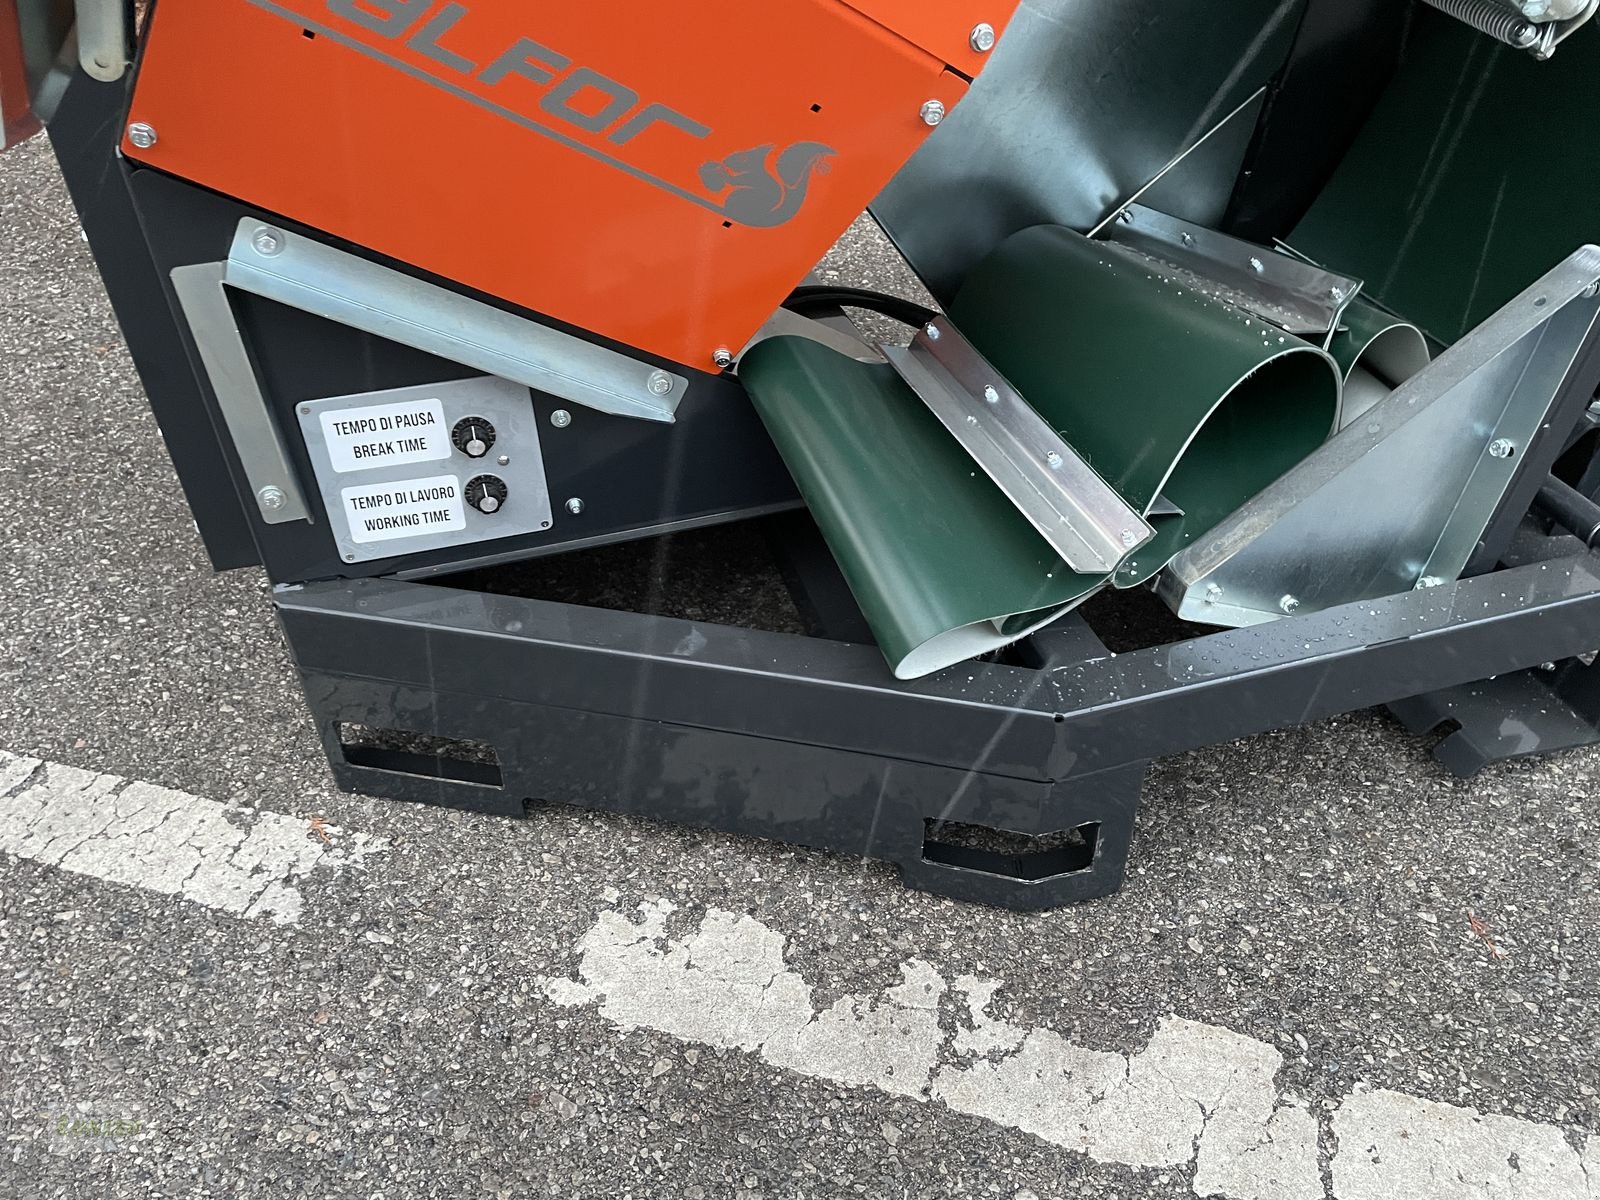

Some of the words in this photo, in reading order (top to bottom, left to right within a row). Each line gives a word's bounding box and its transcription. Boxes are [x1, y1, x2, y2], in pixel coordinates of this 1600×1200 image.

[333, 419, 377, 436] TEMPO
[380, 416, 393, 430] DI
[395, 412, 435, 428] PAUSA
[353, 443, 395, 458] BREAK
[396, 438, 427, 452] TIME
[350, 494, 393, 510] TEMPO
[395, 492, 407, 504] DI
[410, 486, 455, 502] LAVORO
[364, 514, 420, 531] WORKING
[422, 509, 451, 523] TIME
